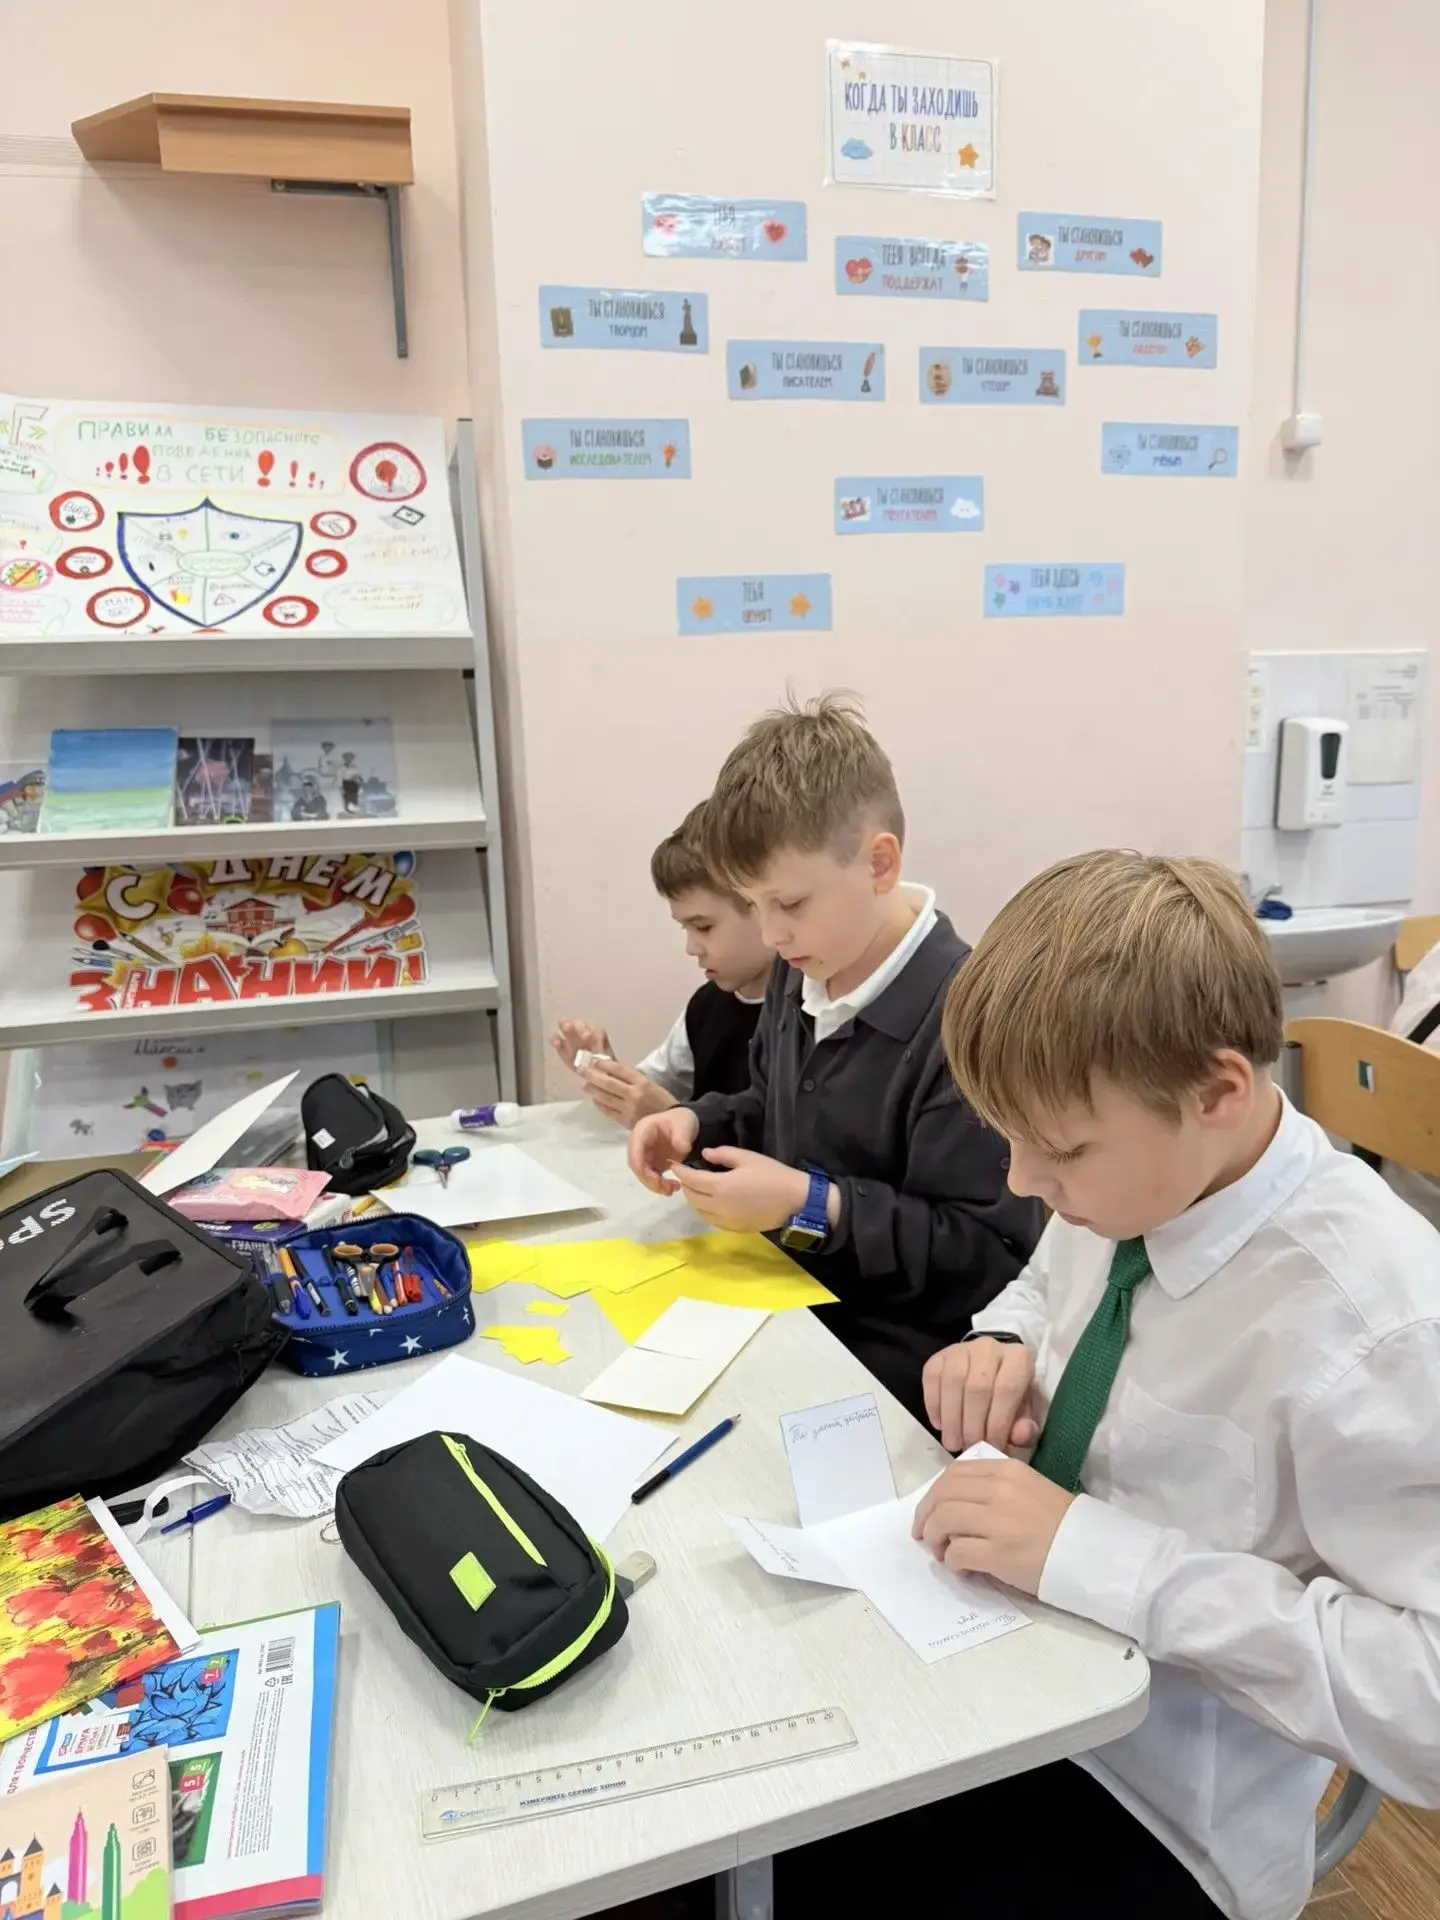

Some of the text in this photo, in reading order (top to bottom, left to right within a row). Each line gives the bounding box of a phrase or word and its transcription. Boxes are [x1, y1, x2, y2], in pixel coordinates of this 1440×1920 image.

[844, 81, 979, 120] КОГДА ТЫ ЗАХОДИШЬ
[889, 122, 942, 153] В КЛАСС
[881, 273, 944, 293] ПОДДЕРЖАТ
[589, 299, 666, 321] ТЫ СТАНОВИШЬСЯ
[608, 324, 648, 340] ТВОРЦОМ
[772, 352, 843, 372] ТЫ СТАНОВИШЬСЯ
[782, 375, 834, 389] ПИСАТЕЛЕМ
[78, 420, 321, 446] ПРАВИЛА БЕЗОПАСНОГО
[569, 429, 646, 449] ТЫ СТАНОВИШЬСЯ
[569, 452, 652, 467] ИССЛЕДОВАТЕЛЕМ
[185, 464, 245, 484] СЕТИ
[105, 873, 159, 921] С
[13, 1728, 37, 1776] ТВОРЧЕСТВ
